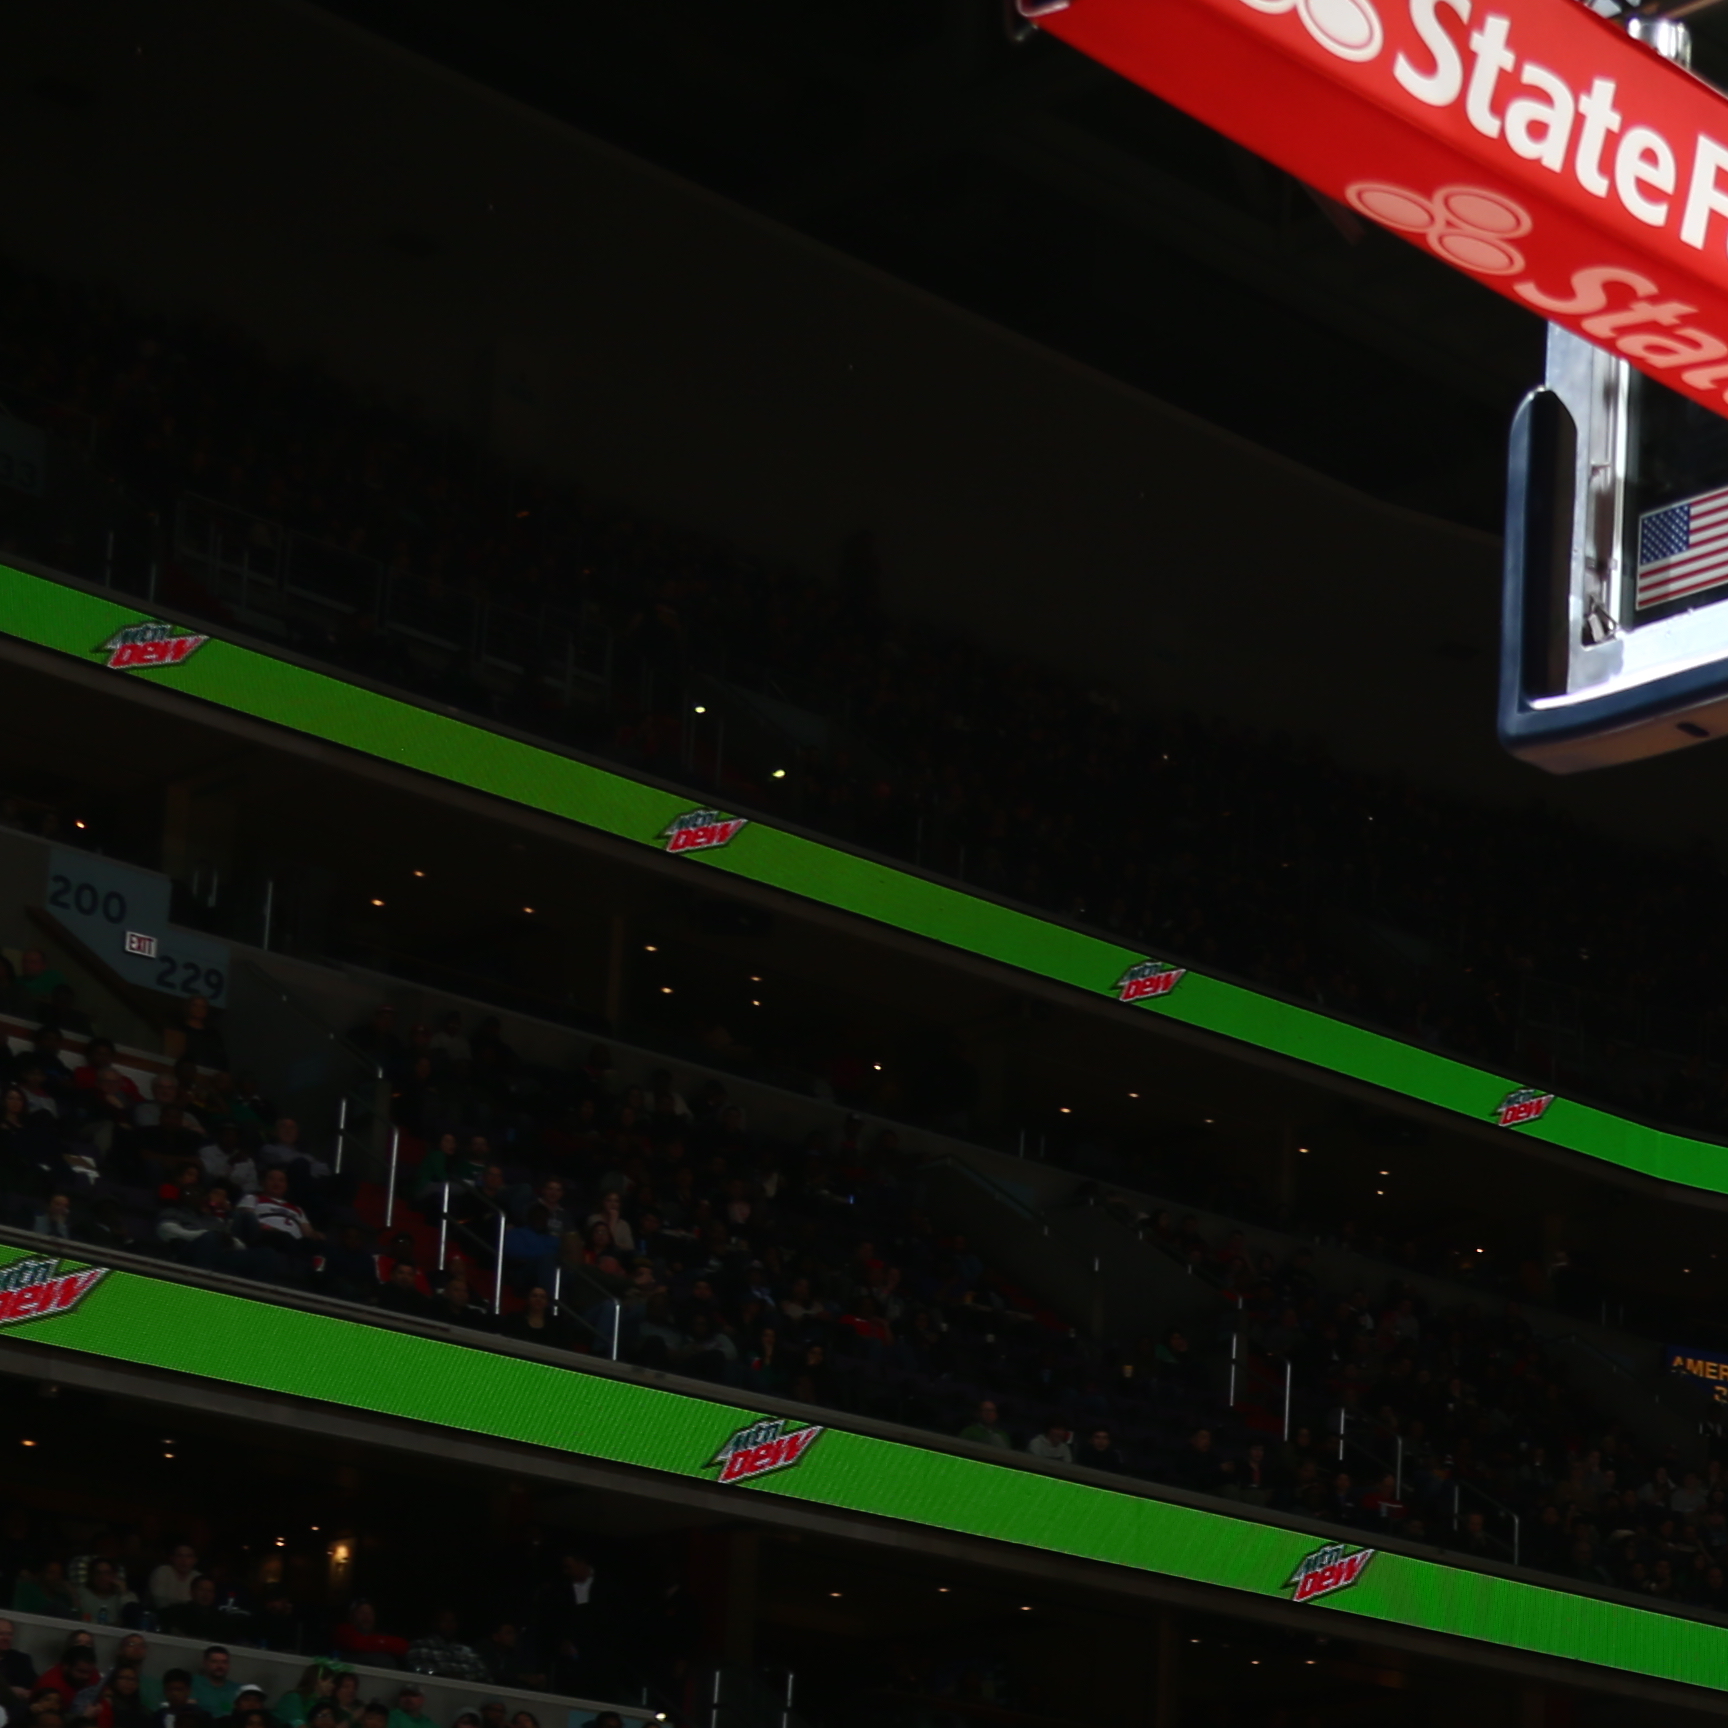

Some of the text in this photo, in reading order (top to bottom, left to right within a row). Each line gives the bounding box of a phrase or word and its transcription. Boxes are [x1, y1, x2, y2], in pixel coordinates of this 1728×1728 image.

[50, 875, 127, 924] 200
[129, 939, 155, 958] EXIT
[156, 955, 224, 1000] 229
